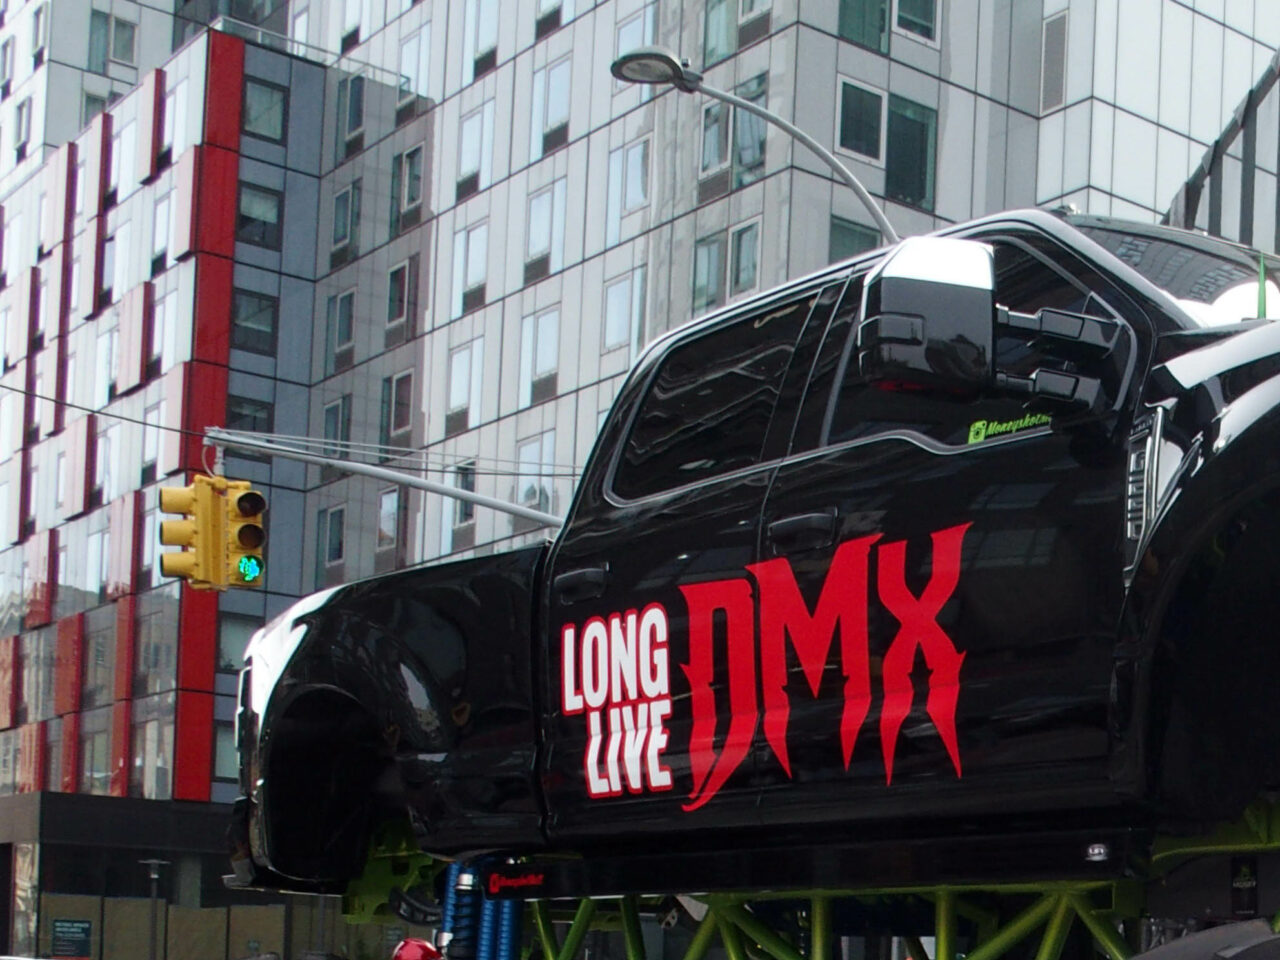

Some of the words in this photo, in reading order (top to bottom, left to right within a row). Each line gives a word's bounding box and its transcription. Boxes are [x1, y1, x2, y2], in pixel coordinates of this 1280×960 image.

[562, 604, 671, 714] LONG
[679, 522, 974, 811] DMX
[586, 699, 673, 797] LIVE
